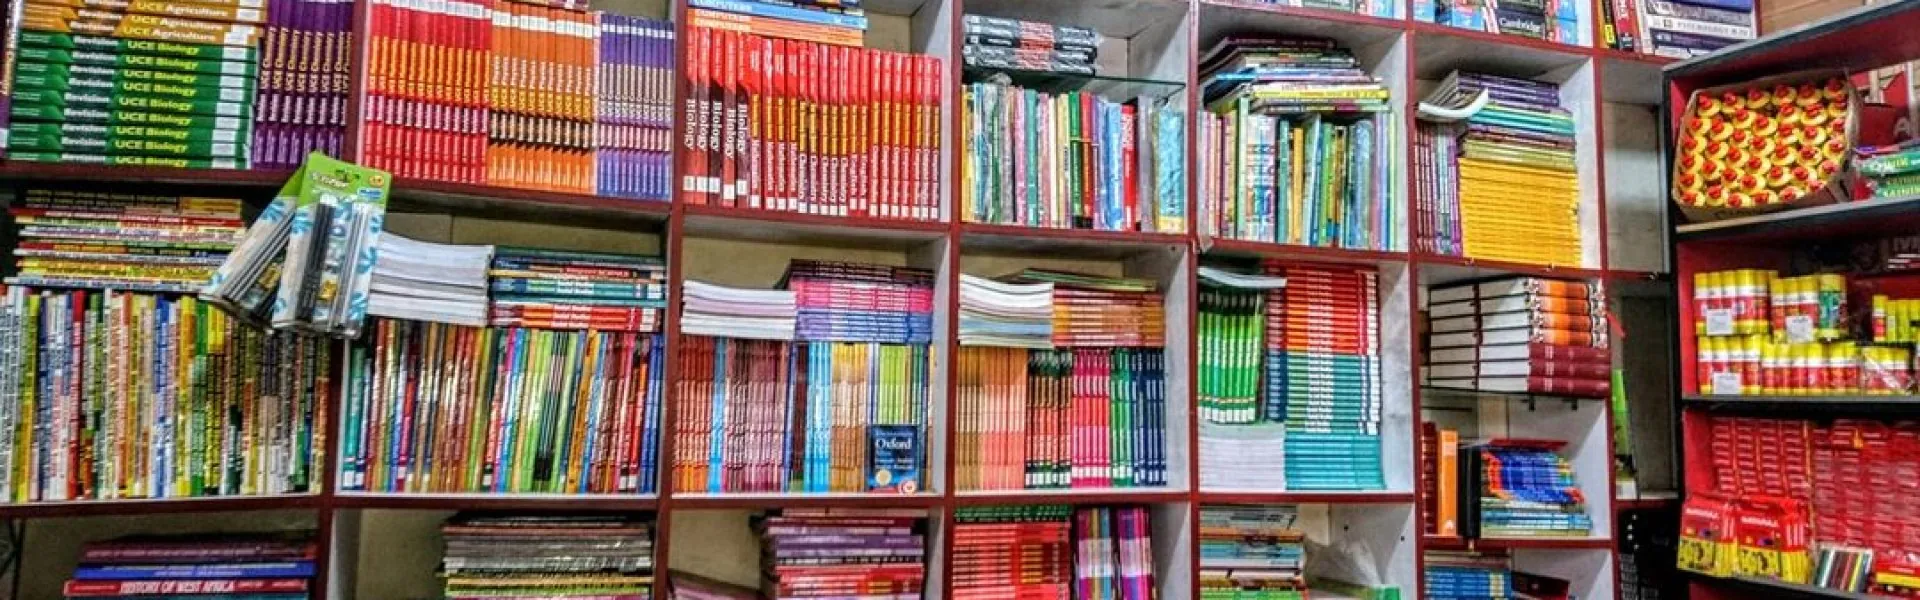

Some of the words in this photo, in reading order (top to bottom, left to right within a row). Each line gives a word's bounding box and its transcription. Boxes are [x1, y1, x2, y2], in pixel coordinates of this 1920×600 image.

[137, 2, 165, 11] UCE
[167, 5, 228, 17] Agriculture
[161, 18, 223, 30] Agriculture
[1499, 18, 1541, 32] Cambridge
[123, 27, 151, 35] UCE
[152, 29, 215, 41] Agriculture
[128, 41, 154, 49] UCE
[158, 43, 200, 55] Biology
[126, 55, 152, 64] UCE
[156, 58, 198, 69] Biology
[123, 70, 150, 78] UCE
[154, 72, 197, 83] Biology
[123, 82, 150, 91] UCE
[154, 85, 197, 97] Biology
[118, 97, 146, 106] UCE
[150, 98, 192, 110] Biology
[118, 112, 146, 121] UCE
[149, 114, 192, 125] Biology
[684, 99, 696, 151] Biology
[116, 127, 144, 135] UCE
[146, 129, 188, 139] Biology
[697, 101, 709, 151] Biology
[710, 101, 722, 152] Biology
[724, 108, 736, 158] Biology
[737, 103, 747, 154] Biology
[115, 140, 144, 149] UCE
[145, 142, 187, 153] Biology
[115, 156, 144, 164] UCE
[145, 157, 187, 167] Biology
[876, 437, 912, 449] Oxford
[161, 581, 176, 593] OF
